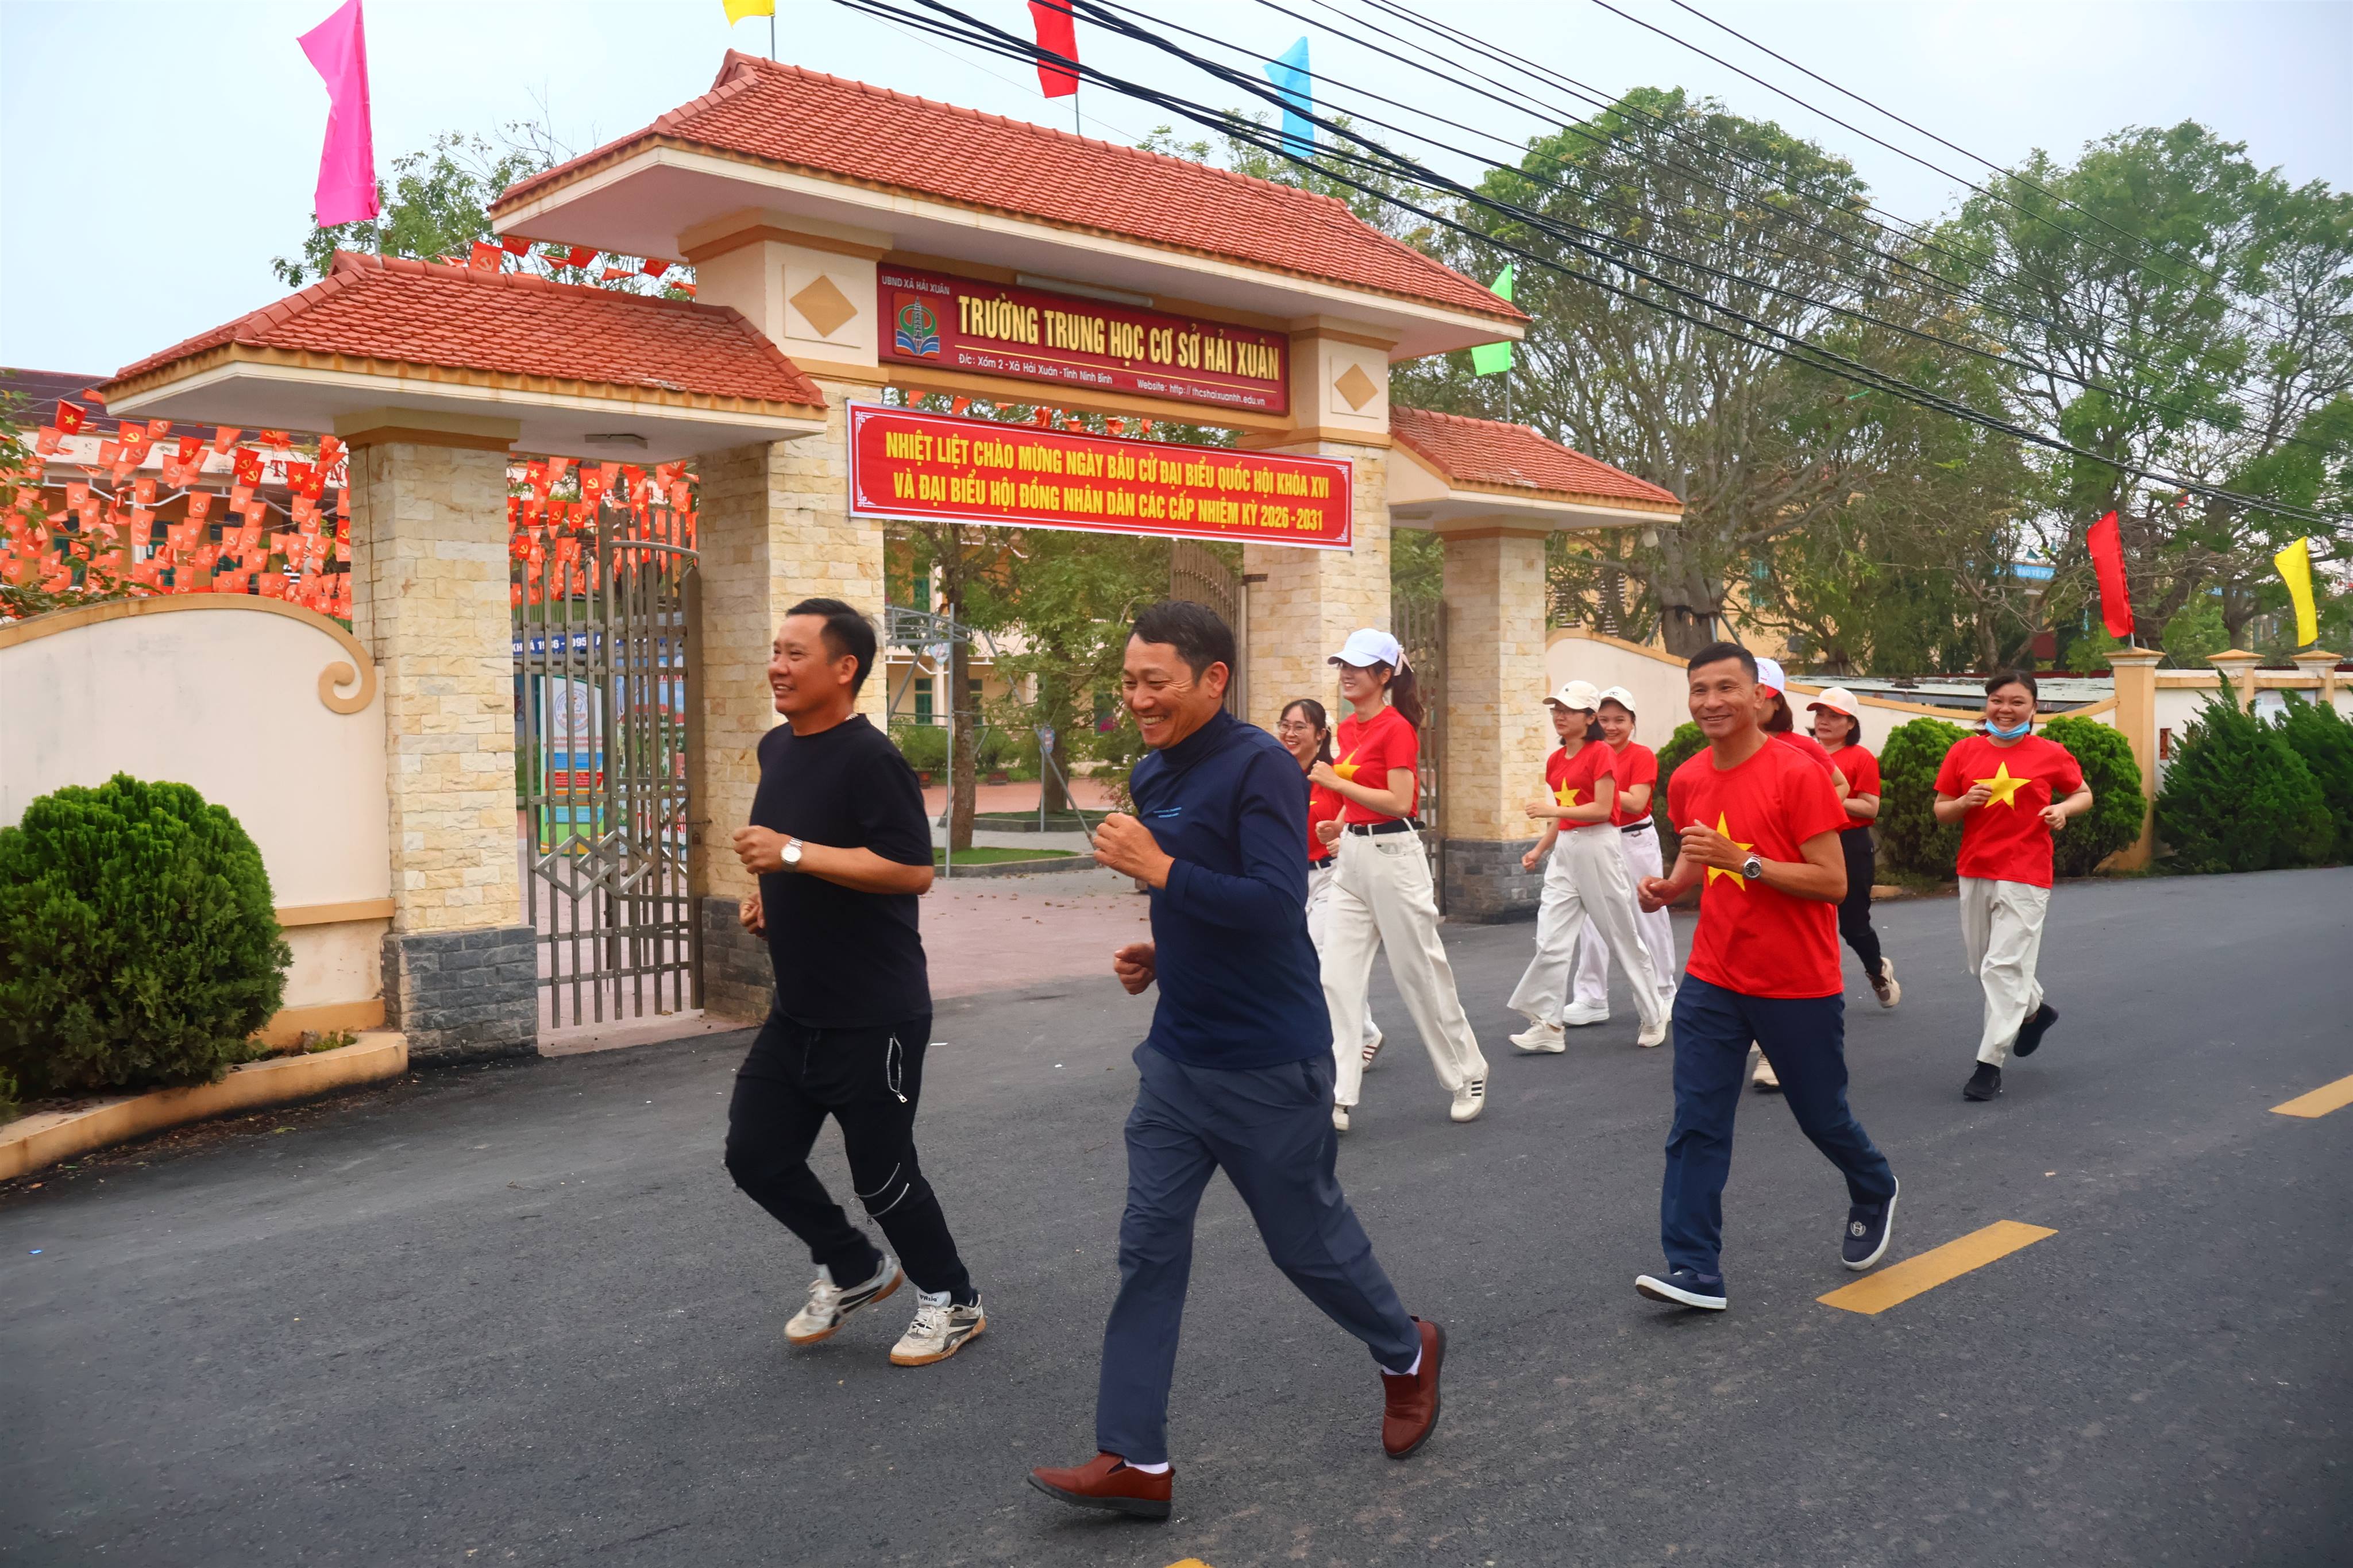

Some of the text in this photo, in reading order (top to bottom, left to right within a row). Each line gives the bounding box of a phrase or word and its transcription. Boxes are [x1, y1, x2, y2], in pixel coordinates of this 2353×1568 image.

[882, 276, 950, 295] UBND XÃ HẢI XUÂN
[958, 293, 1279, 380] TRƯỜNG TRUNG HỌC CƠ SỞ HẢI XUÂN
[958, 353, 975, 365] Đ/c:
[977, 356, 996, 368] Xóm
[1023, 361, 1036, 373] Hải
[1038, 365, 1058, 377] Xuân
[1080, 371, 1096, 382] Ninh
[1098, 373, 1112, 384] Bình
[1137, 379, 1167, 392] Website:
[886, 429, 1329, 499] NHIỆT LIỆT CHÀO MỪNG NGÀY BẦU CỬ ĐẠI BIỂU QUỐC HỘI KHÓA XVI
[893, 468, 915, 499] VÀ
[919, 474, 946, 507] ĐẠI
[950, 469, 986, 504] BIỂU
[990, 477, 1015, 512] HỘI
[1019, 476, 1060, 511] ĐỒNG
[1063, 484, 1103, 514] NHÂN
[1106, 487, 1135, 516] DÂN
[1139, 490, 1165, 519] CÁC
[1169, 489, 1195, 521] CẤP
[1198, 496, 1239, 528] NHIỆM
[1241, 499, 1258, 526] KỲ
